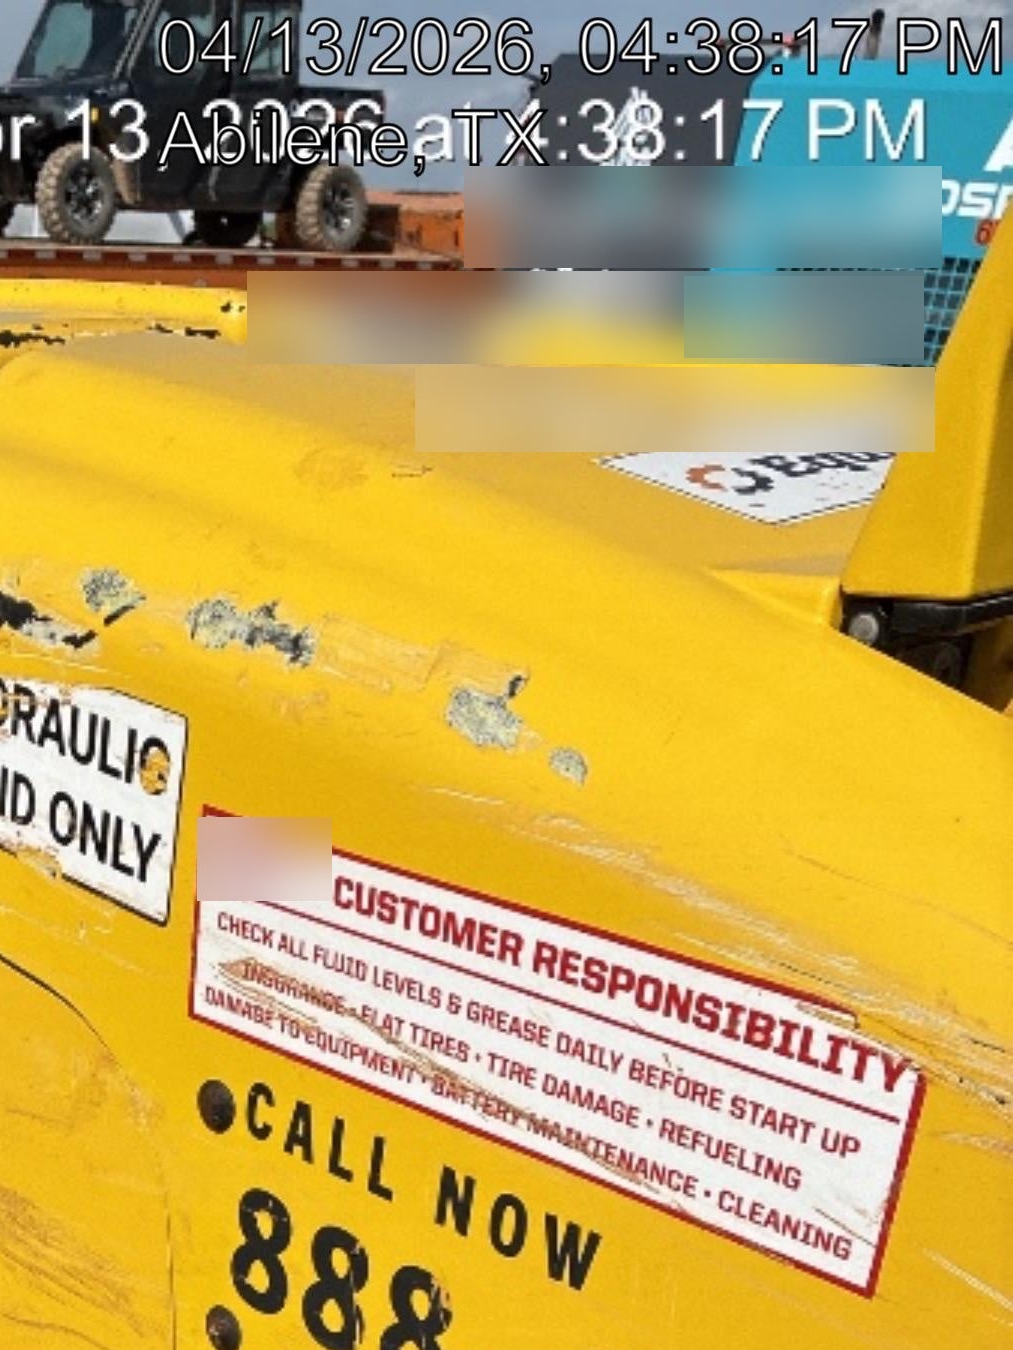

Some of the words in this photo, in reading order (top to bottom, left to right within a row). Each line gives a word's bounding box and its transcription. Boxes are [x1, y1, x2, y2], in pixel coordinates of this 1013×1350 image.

[49, 791, 162, 883] ONLY
[217, 911, 274, 949] CHECK
[278, 931, 309, 961] ALL
[313, 945, 367, 982] FLUID
[372, 965, 441, 1009] LEVELS
[467, 1001, 551, 1048] GREASE
[556, 1031, 624, 1074] DAILY
[628, 1058, 725, 1111] BEFORE
[729, 1094, 815, 1144] START
[821, 1127, 861, 1158] UP
[333, 875, 524, 970] CUSTOMER
[532, 940, 912, 1093] RESPONSIBILITY
[204, 986, 274, 1027] DAMAGE
[278, 1010, 300, 1039] TO
[304, 1031, 416, 1084] EQUIPMENT
[526, 1111, 699, 1198] MAINTENANCE
[718, 1190, 854, 1261] CLEANING
[246, 1082, 393, 1202] CALL
[434, 1164, 602, 1291] NOW
[361, 1003, 404, 1037] FLAT
[410, 1021, 469, 1063] TIRES
[488, 1051, 537, 1090] TIRE
[542, 1073, 640, 1128] DAMAGE
[659, 1117, 802, 1192] REFUELING
